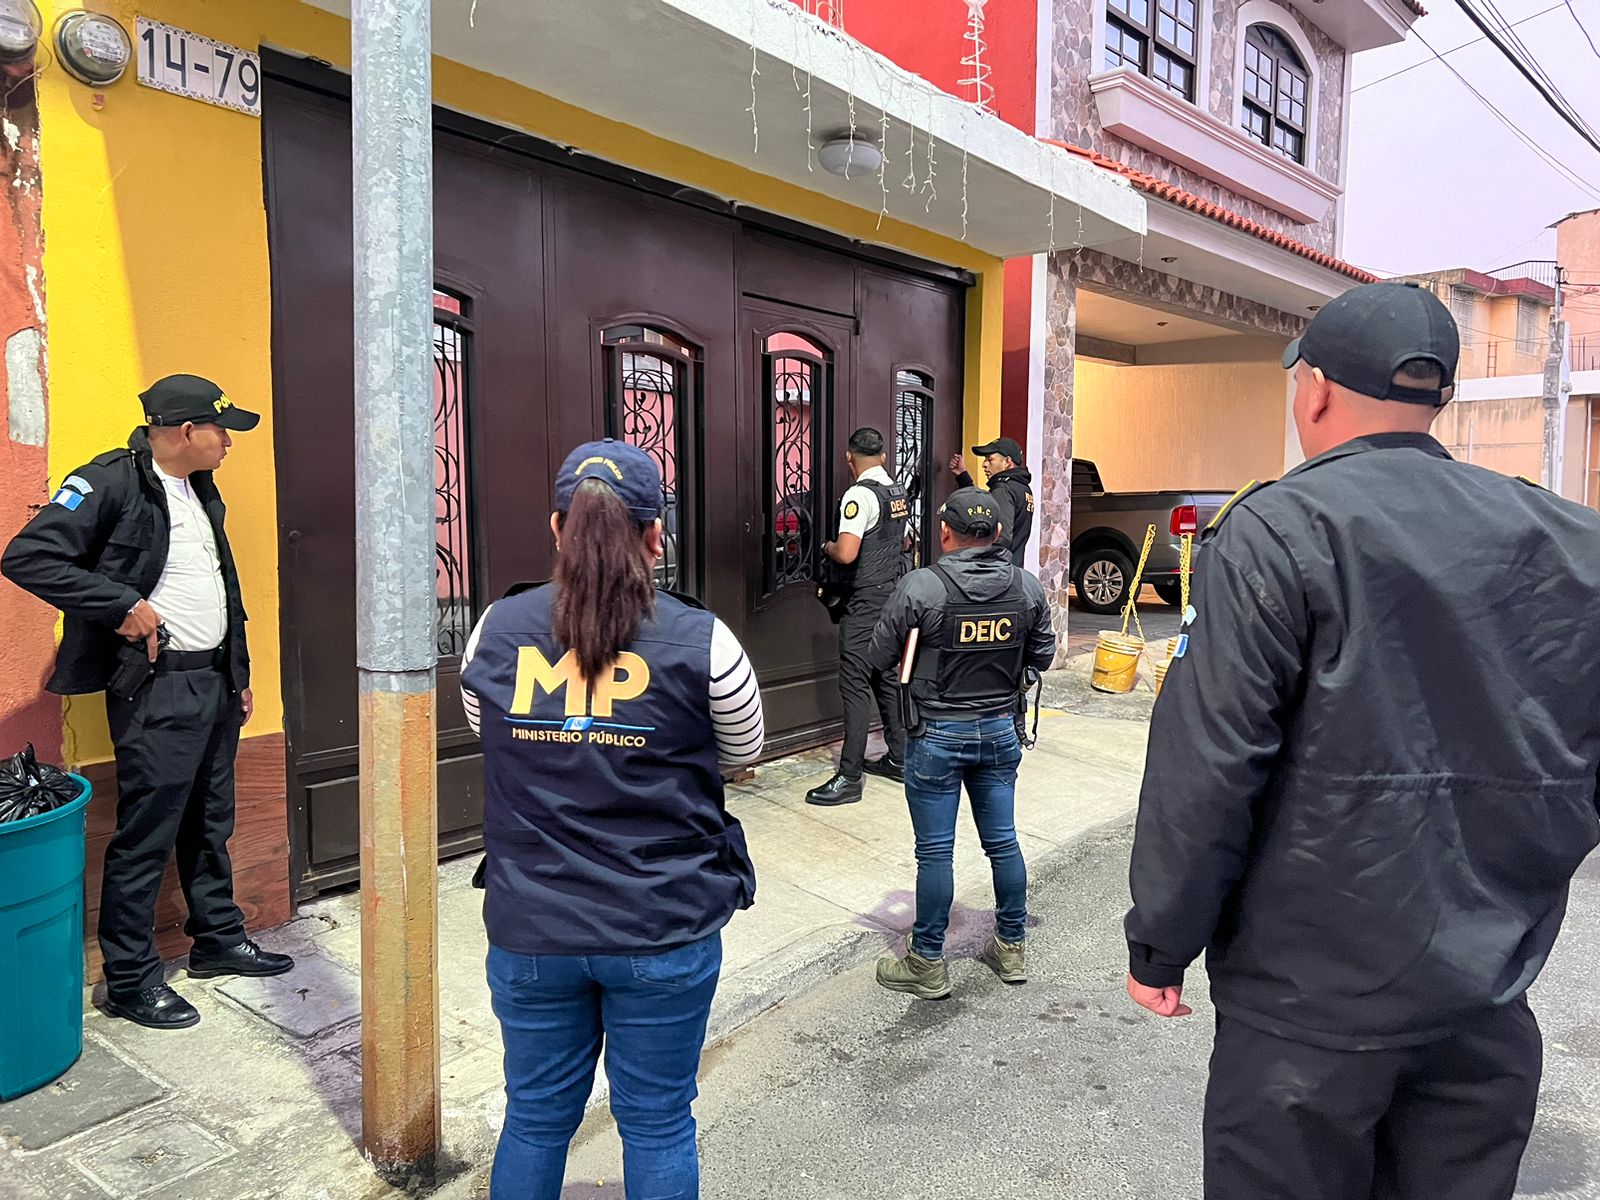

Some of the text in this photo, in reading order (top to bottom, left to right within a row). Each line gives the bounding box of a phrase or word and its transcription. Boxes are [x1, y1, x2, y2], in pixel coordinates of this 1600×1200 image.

[142, 28, 259, 106] 14-79
[960, 618, 1012, 643] DEIC
[509, 646, 650, 717] MP
[512, 727, 646, 747] MINISTERIO PÚBLICO
